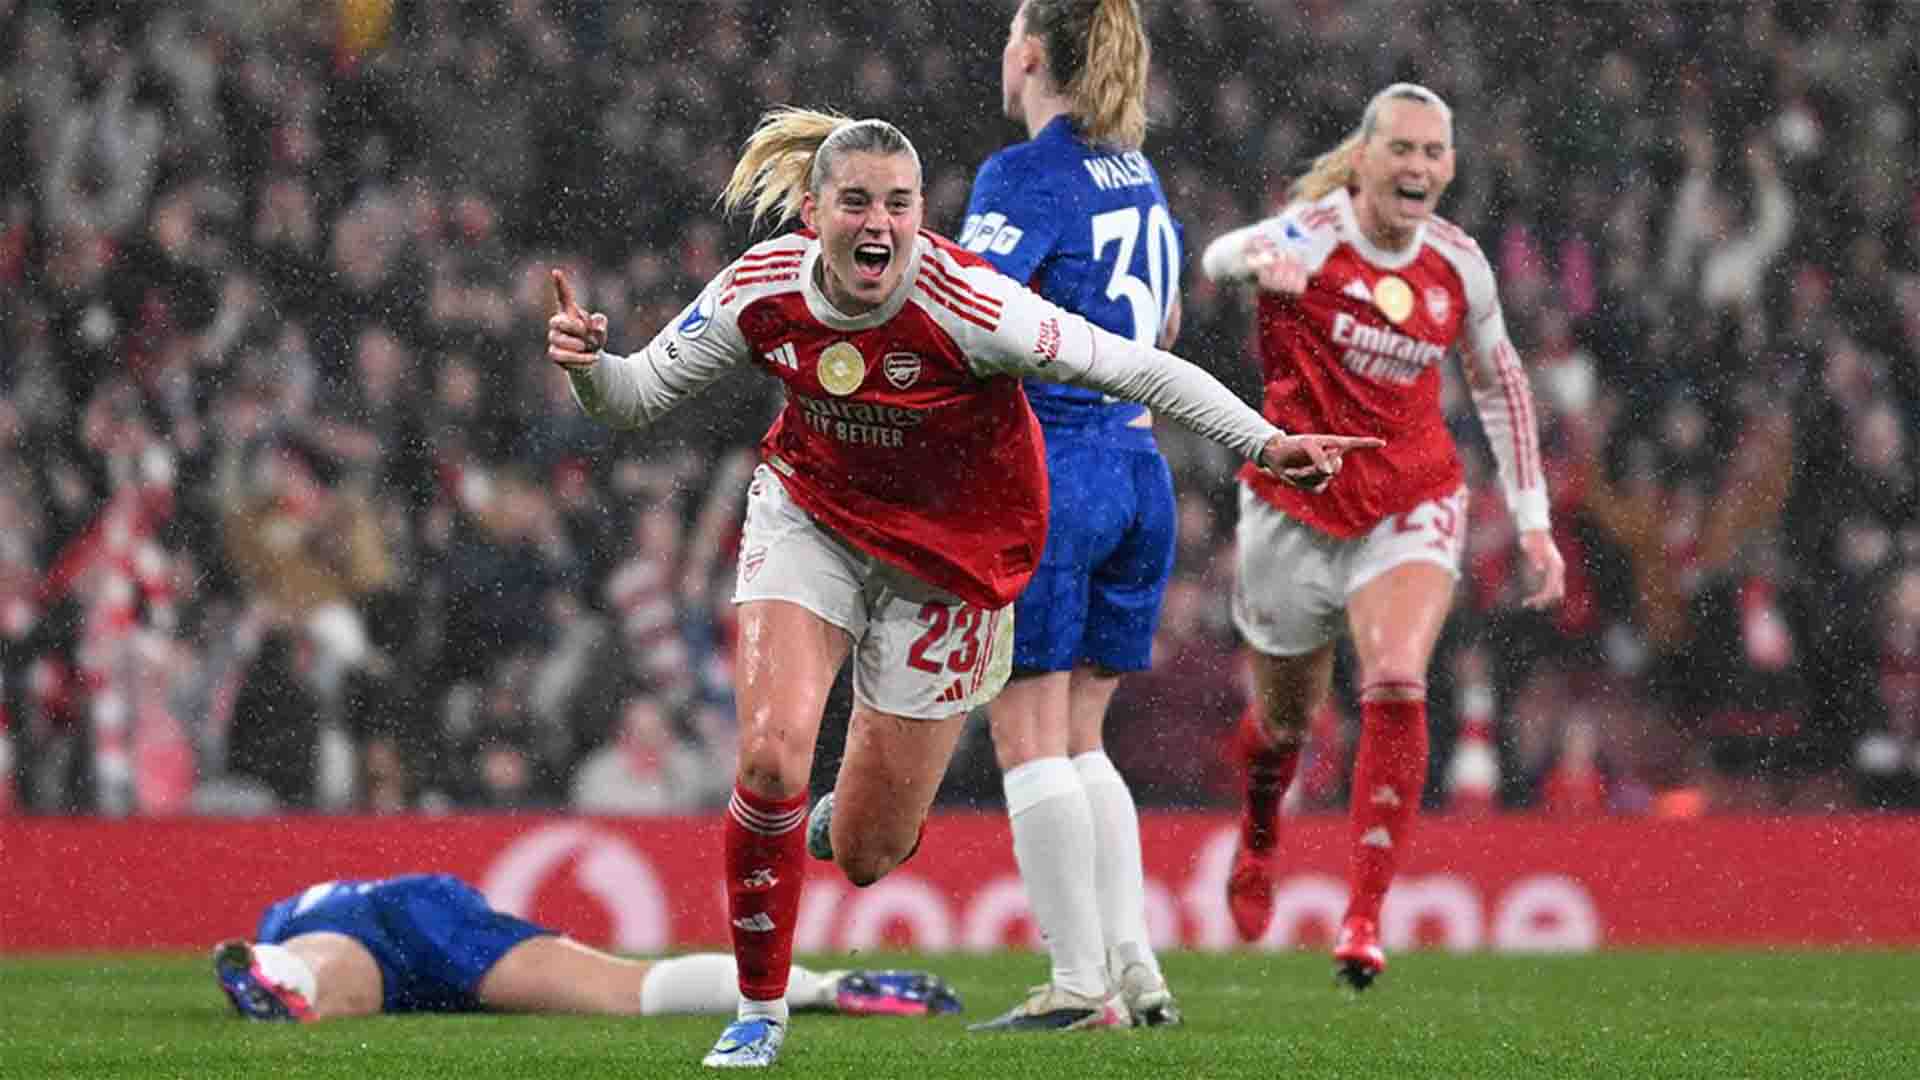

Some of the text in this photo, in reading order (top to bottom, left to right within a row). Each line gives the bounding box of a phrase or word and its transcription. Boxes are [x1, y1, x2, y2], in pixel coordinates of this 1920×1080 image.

[1091, 203, 1181, 349] 30
[835, 421, 905, 448] BETTER
[906, 602, 983, 675] 23
